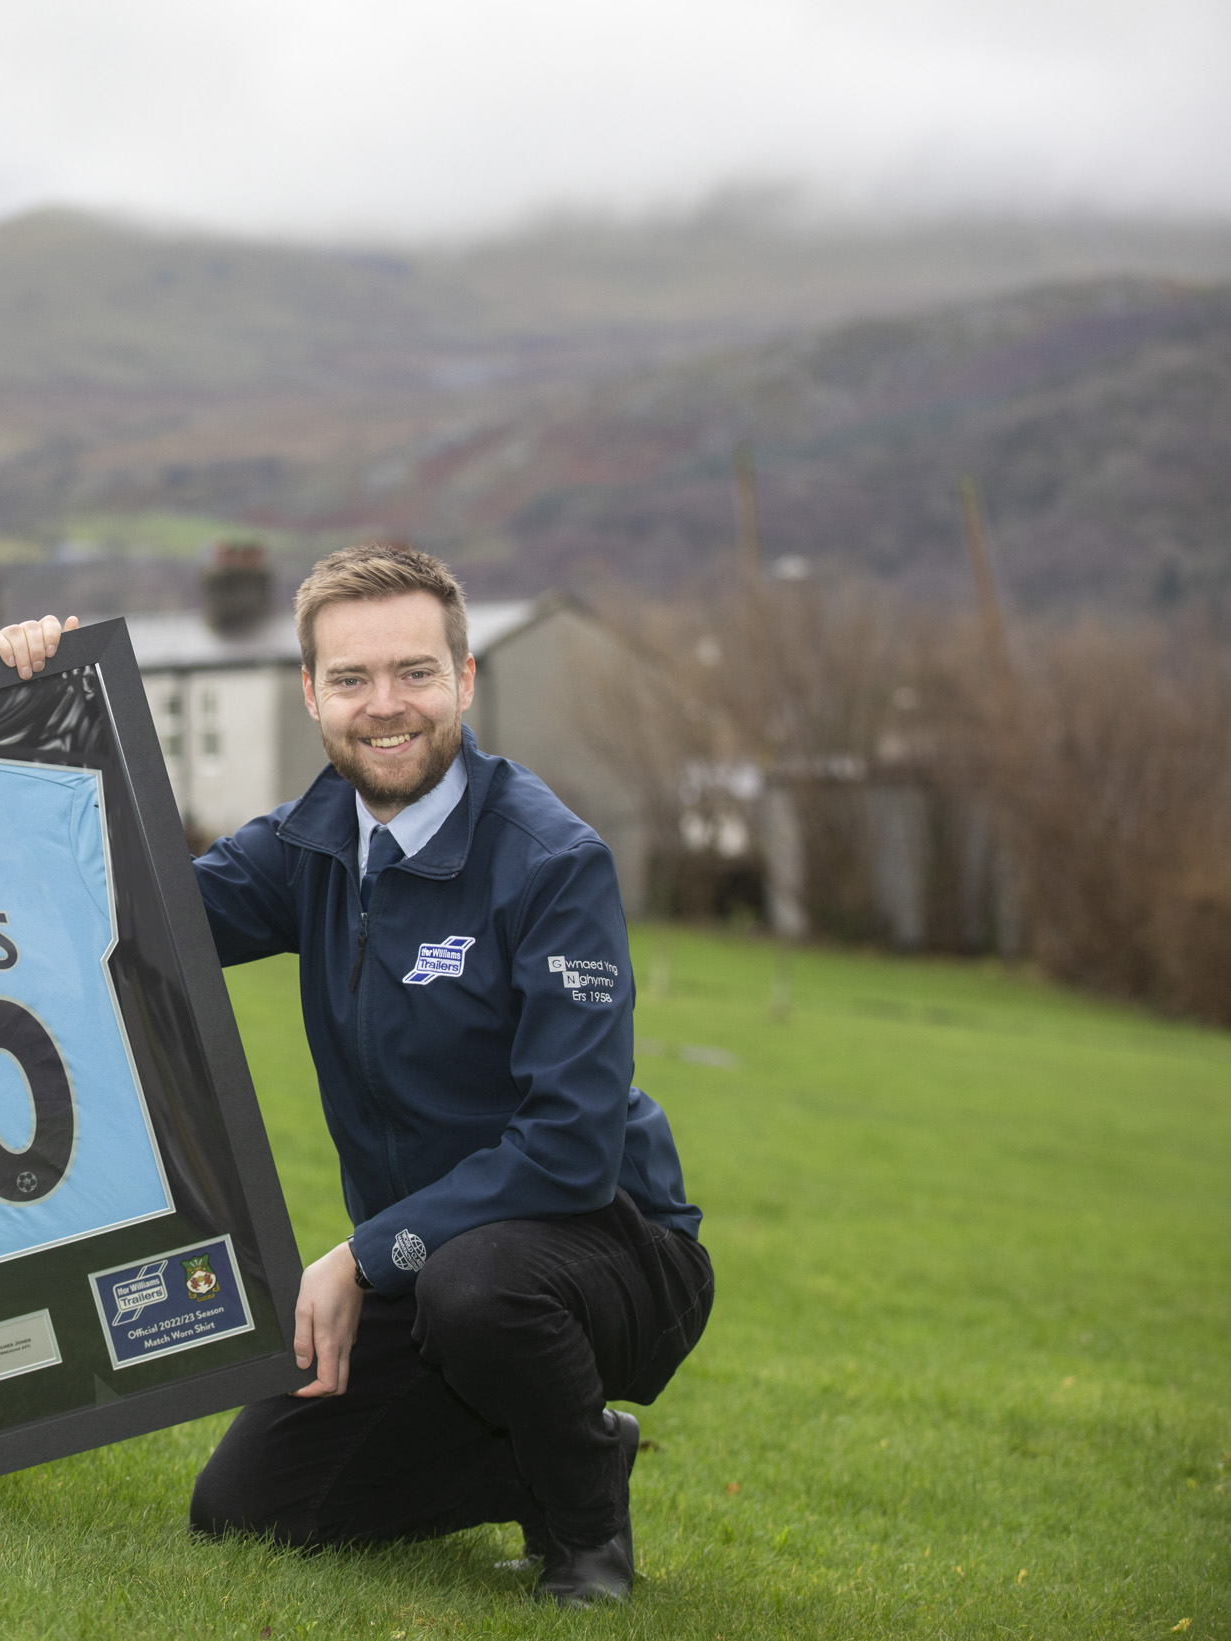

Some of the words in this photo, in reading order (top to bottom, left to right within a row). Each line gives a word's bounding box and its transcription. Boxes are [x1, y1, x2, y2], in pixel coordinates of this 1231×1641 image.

[432, 948, 461, 960] Williams
[420, 959, 458, 972] Trailers
[551, 958, 603, 970] Gwnaed
[604, 961, 618, 976] Yng
[566, 974, 614, 988] Nghymru
[572, 990, 586, 1002] Ers
[590, 992, 612, 1002] 1958
[117, 1287, 130, 1296] Ifor
[130, 1278, 160, 1292] Williams
[121, 1290, 162, 1306] Trailers
[128, 1324, 158, 1339] Official
[159, 1313, 195, 1331] 2022/23
[196, 1306, 224, 1320] Season
[144, 1334, 170, 1348] Match
[170, 1330, 194, 1340] Worn
[194, 1322, 216, 1333] Shirt
